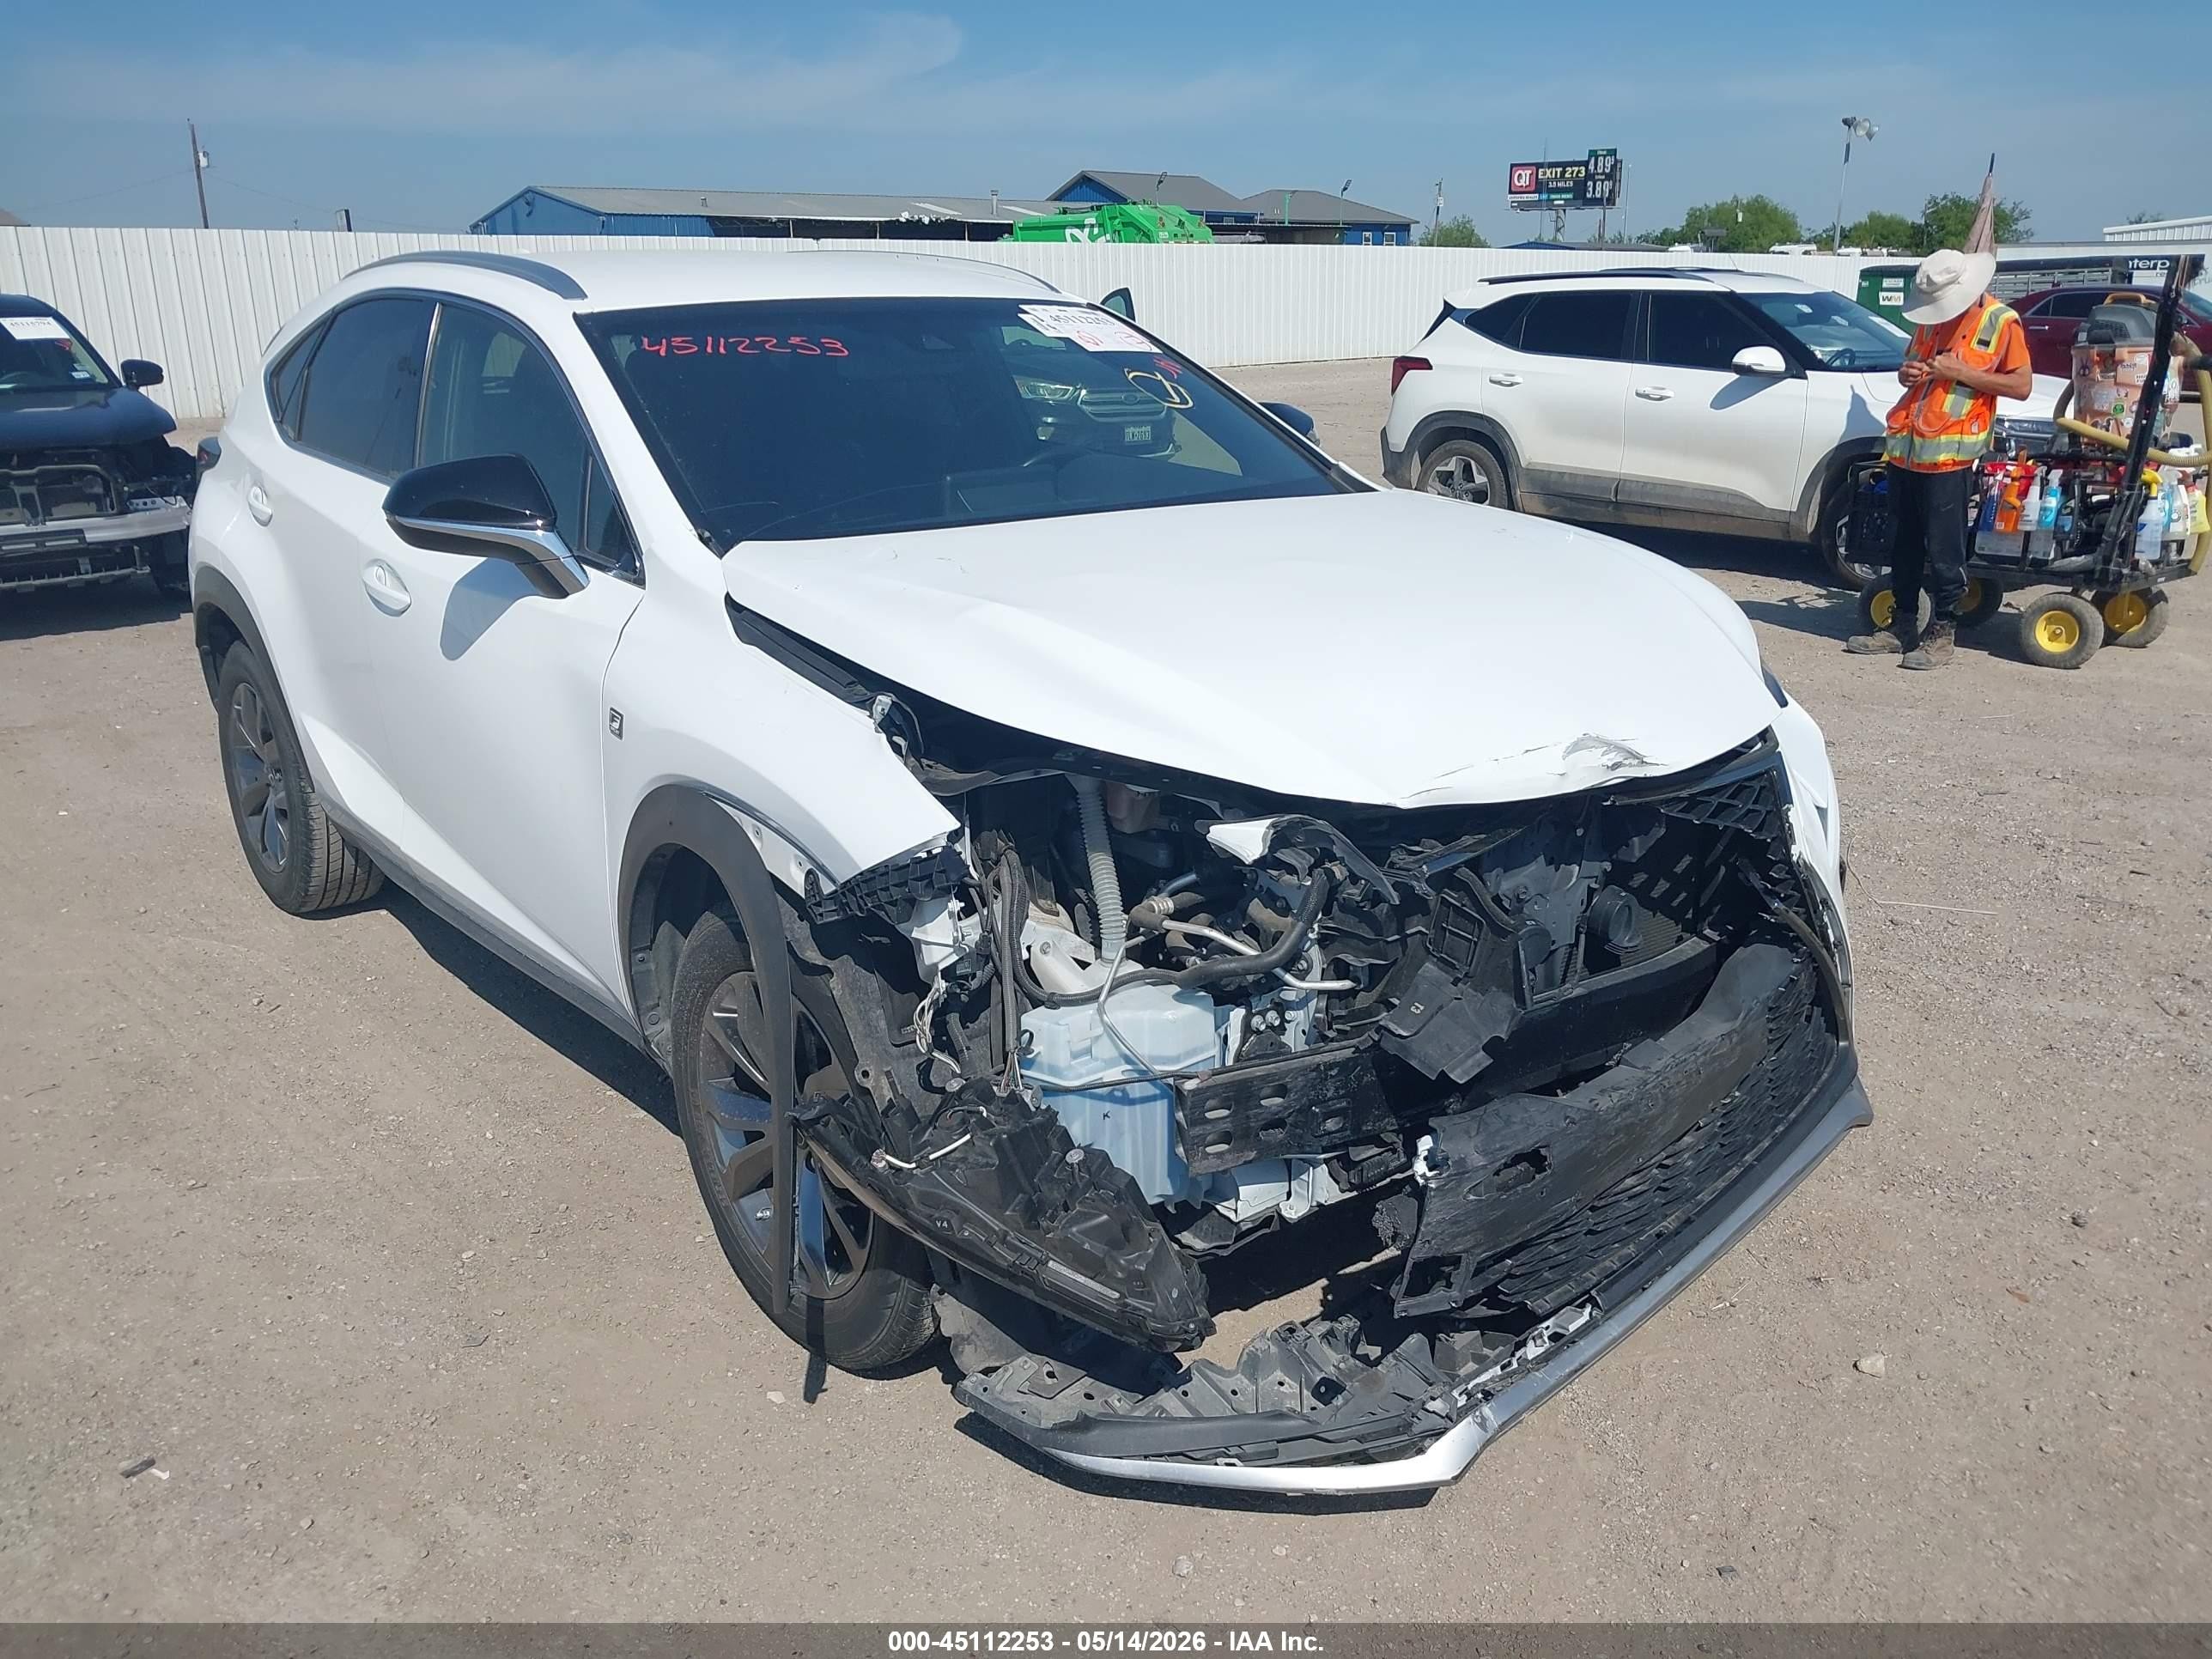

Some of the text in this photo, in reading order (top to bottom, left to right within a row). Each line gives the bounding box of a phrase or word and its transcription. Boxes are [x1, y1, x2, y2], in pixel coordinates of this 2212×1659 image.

[1514, 166, 1586, 187] QT EXIT 273
[641, 335, 850, 357] 45112253
[1103, 1110, 1111, 1120] K
[935, 1220, 948, 1229] V4
